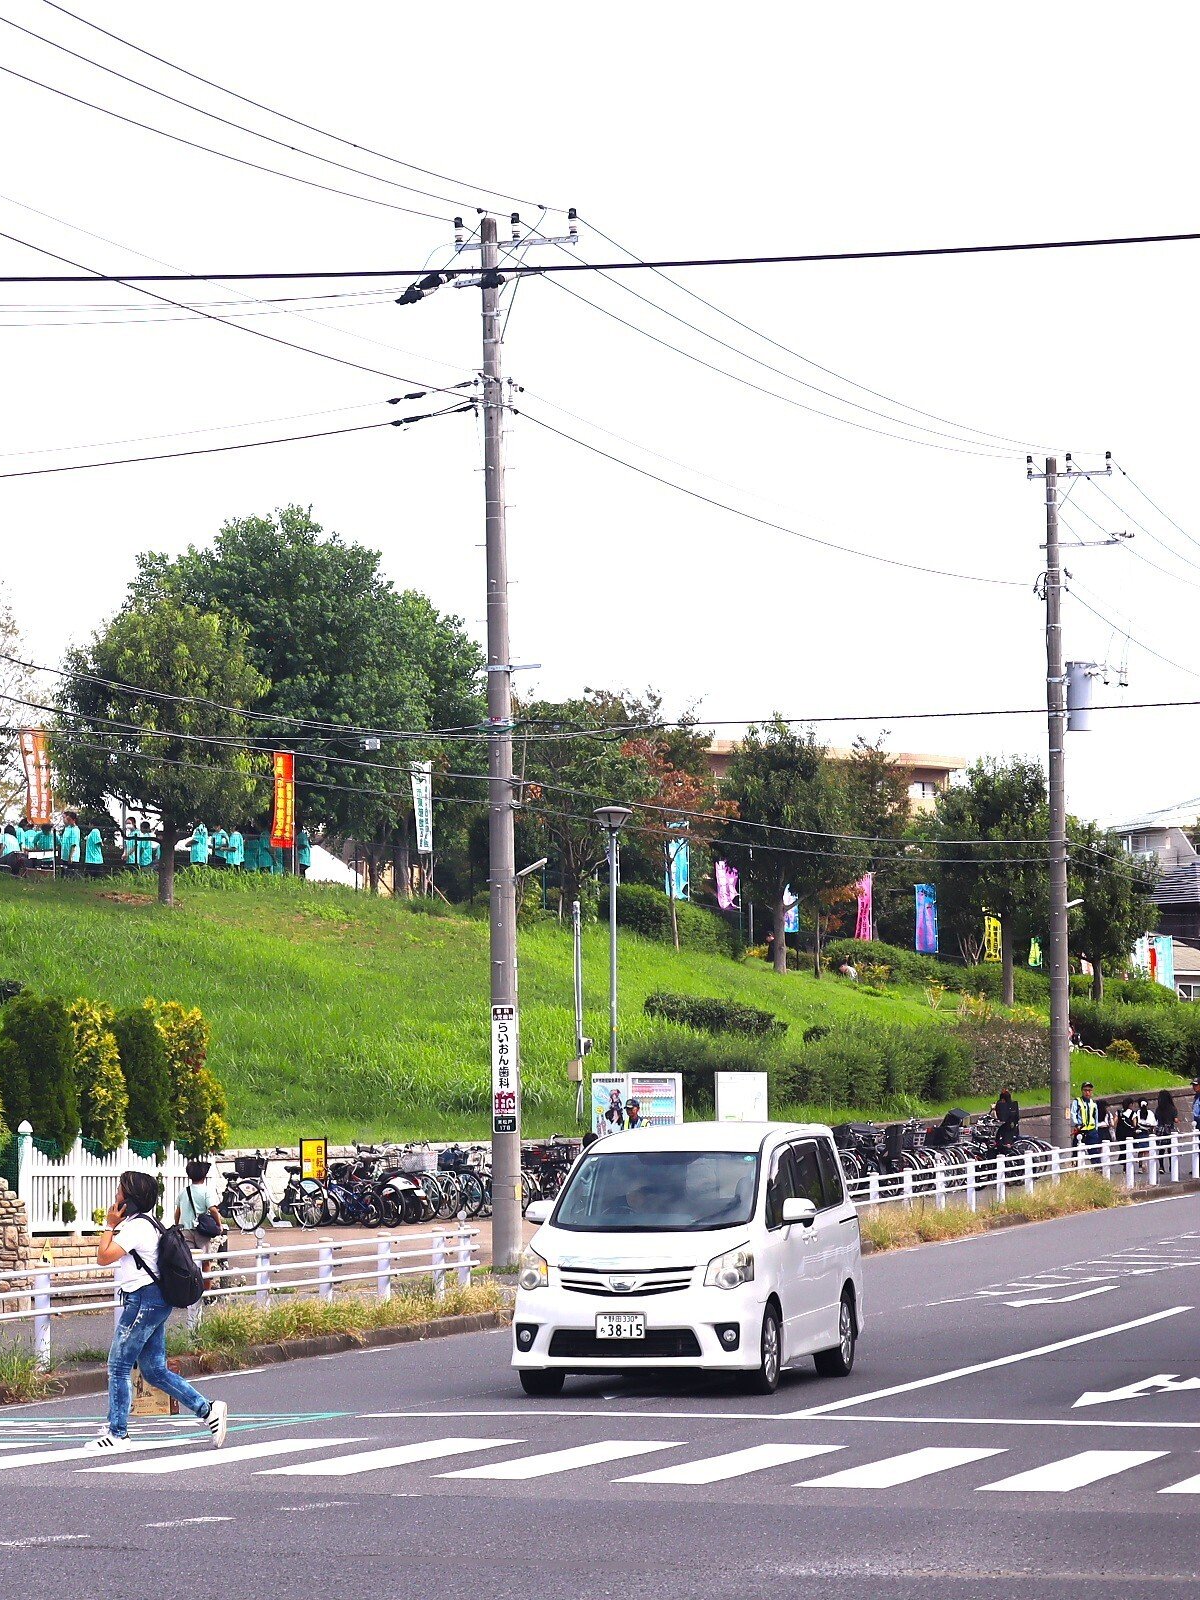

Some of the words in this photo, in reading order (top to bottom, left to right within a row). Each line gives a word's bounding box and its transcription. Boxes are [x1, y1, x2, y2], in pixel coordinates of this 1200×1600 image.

[498, 1022, 510, 1089] らいおん歯科
[607, 1323, 643, 1336] 38-15
